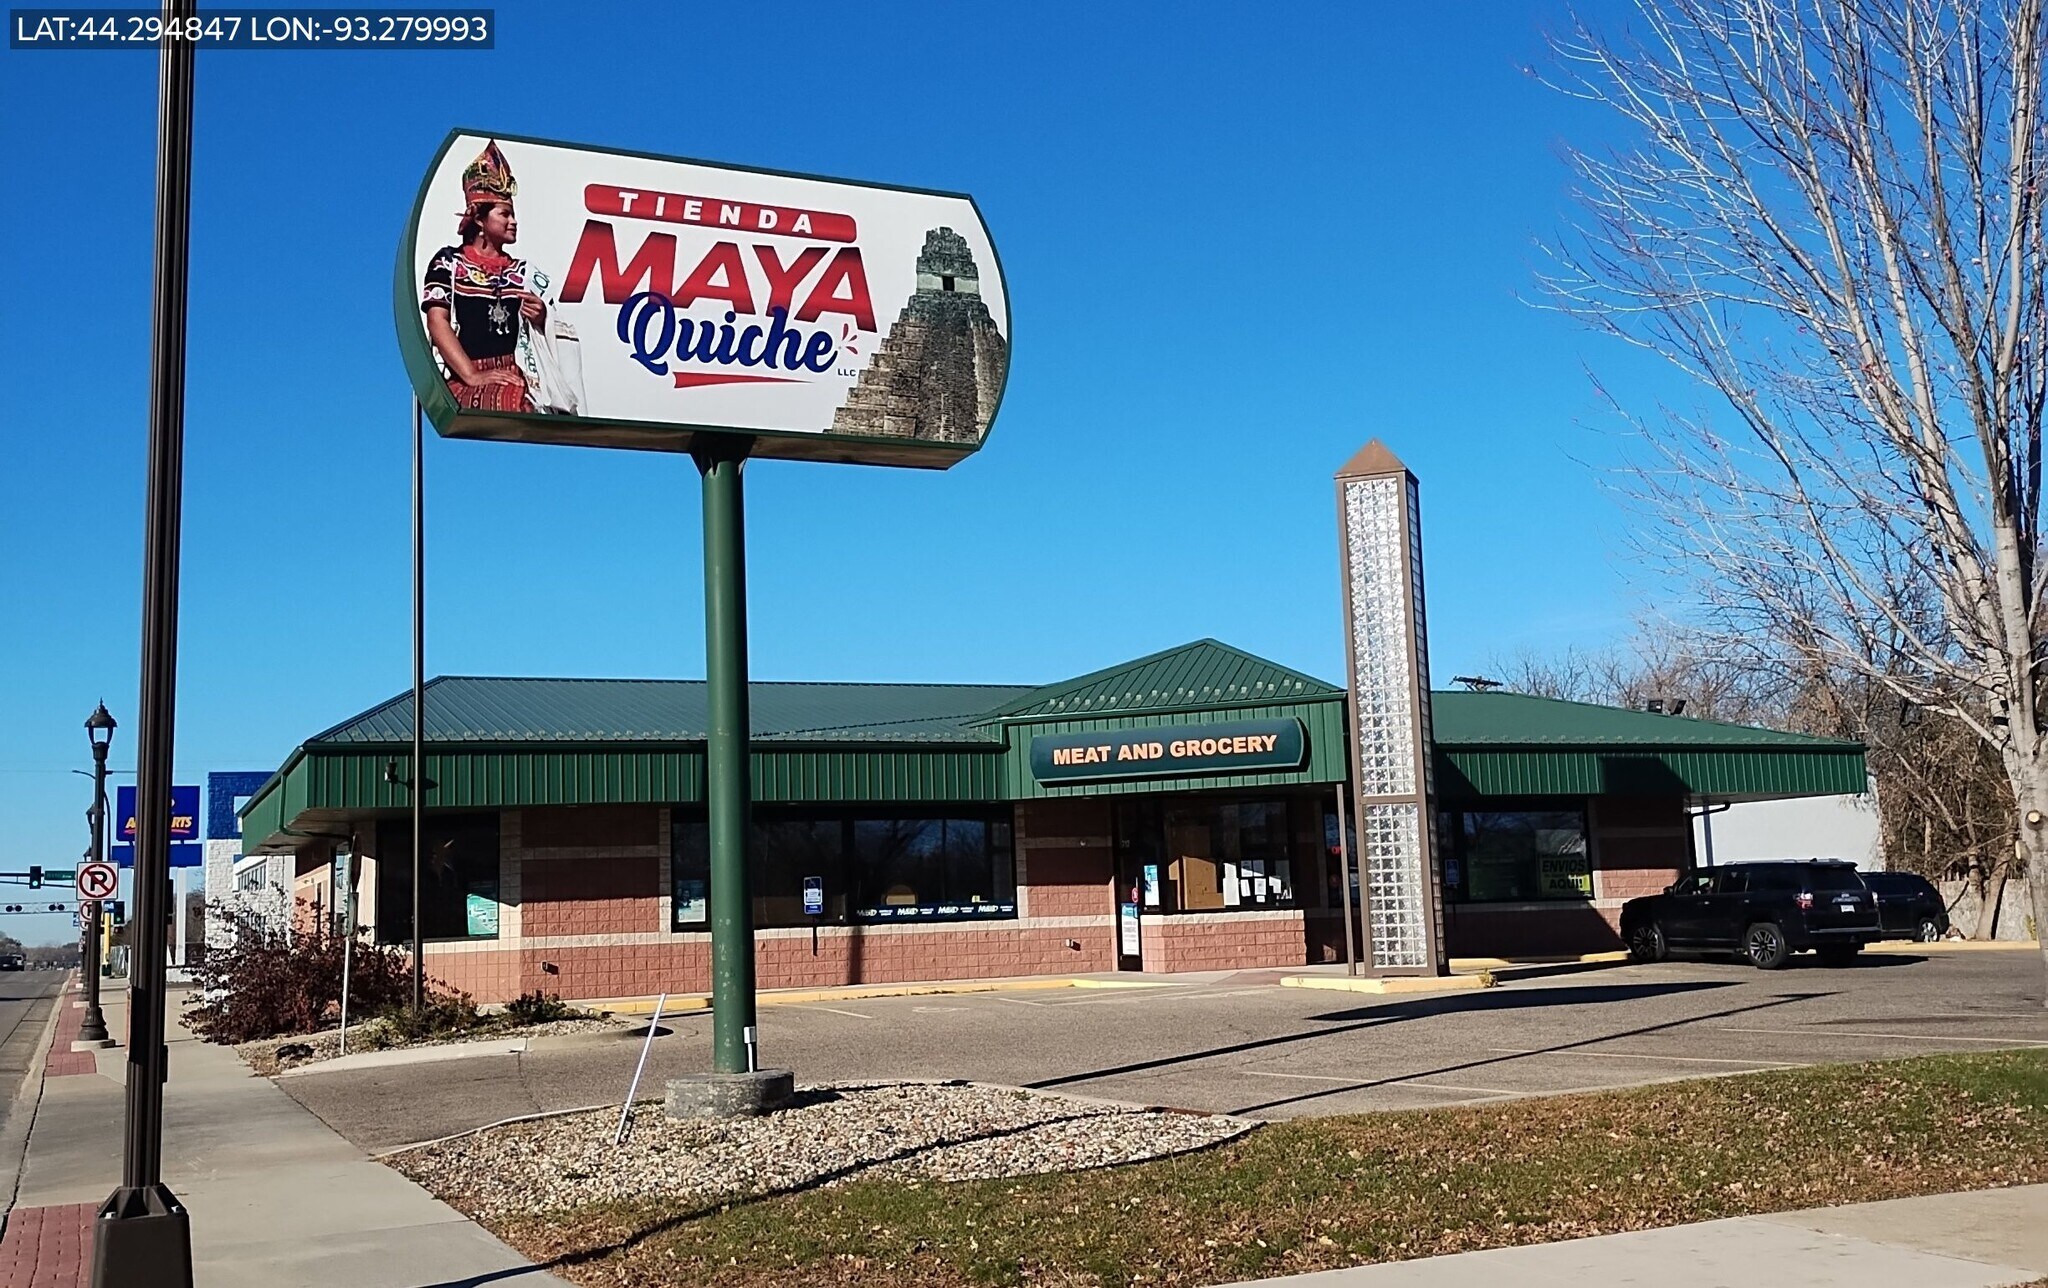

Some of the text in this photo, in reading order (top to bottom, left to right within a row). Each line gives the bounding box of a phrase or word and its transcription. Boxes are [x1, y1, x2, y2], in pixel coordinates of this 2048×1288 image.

[618, 191, 814, 234] TIENDA
[558, 218, 878, 333] MAYA
[616, 290, 839, 376] Quiche
[837, 368, 857, 377] LLC
[1053, 734, 1278, 765] MEAT AND GROCERY
[171, 816, 193, 828] RTS
[1542, 859, 1586, 873] ENVIOS
